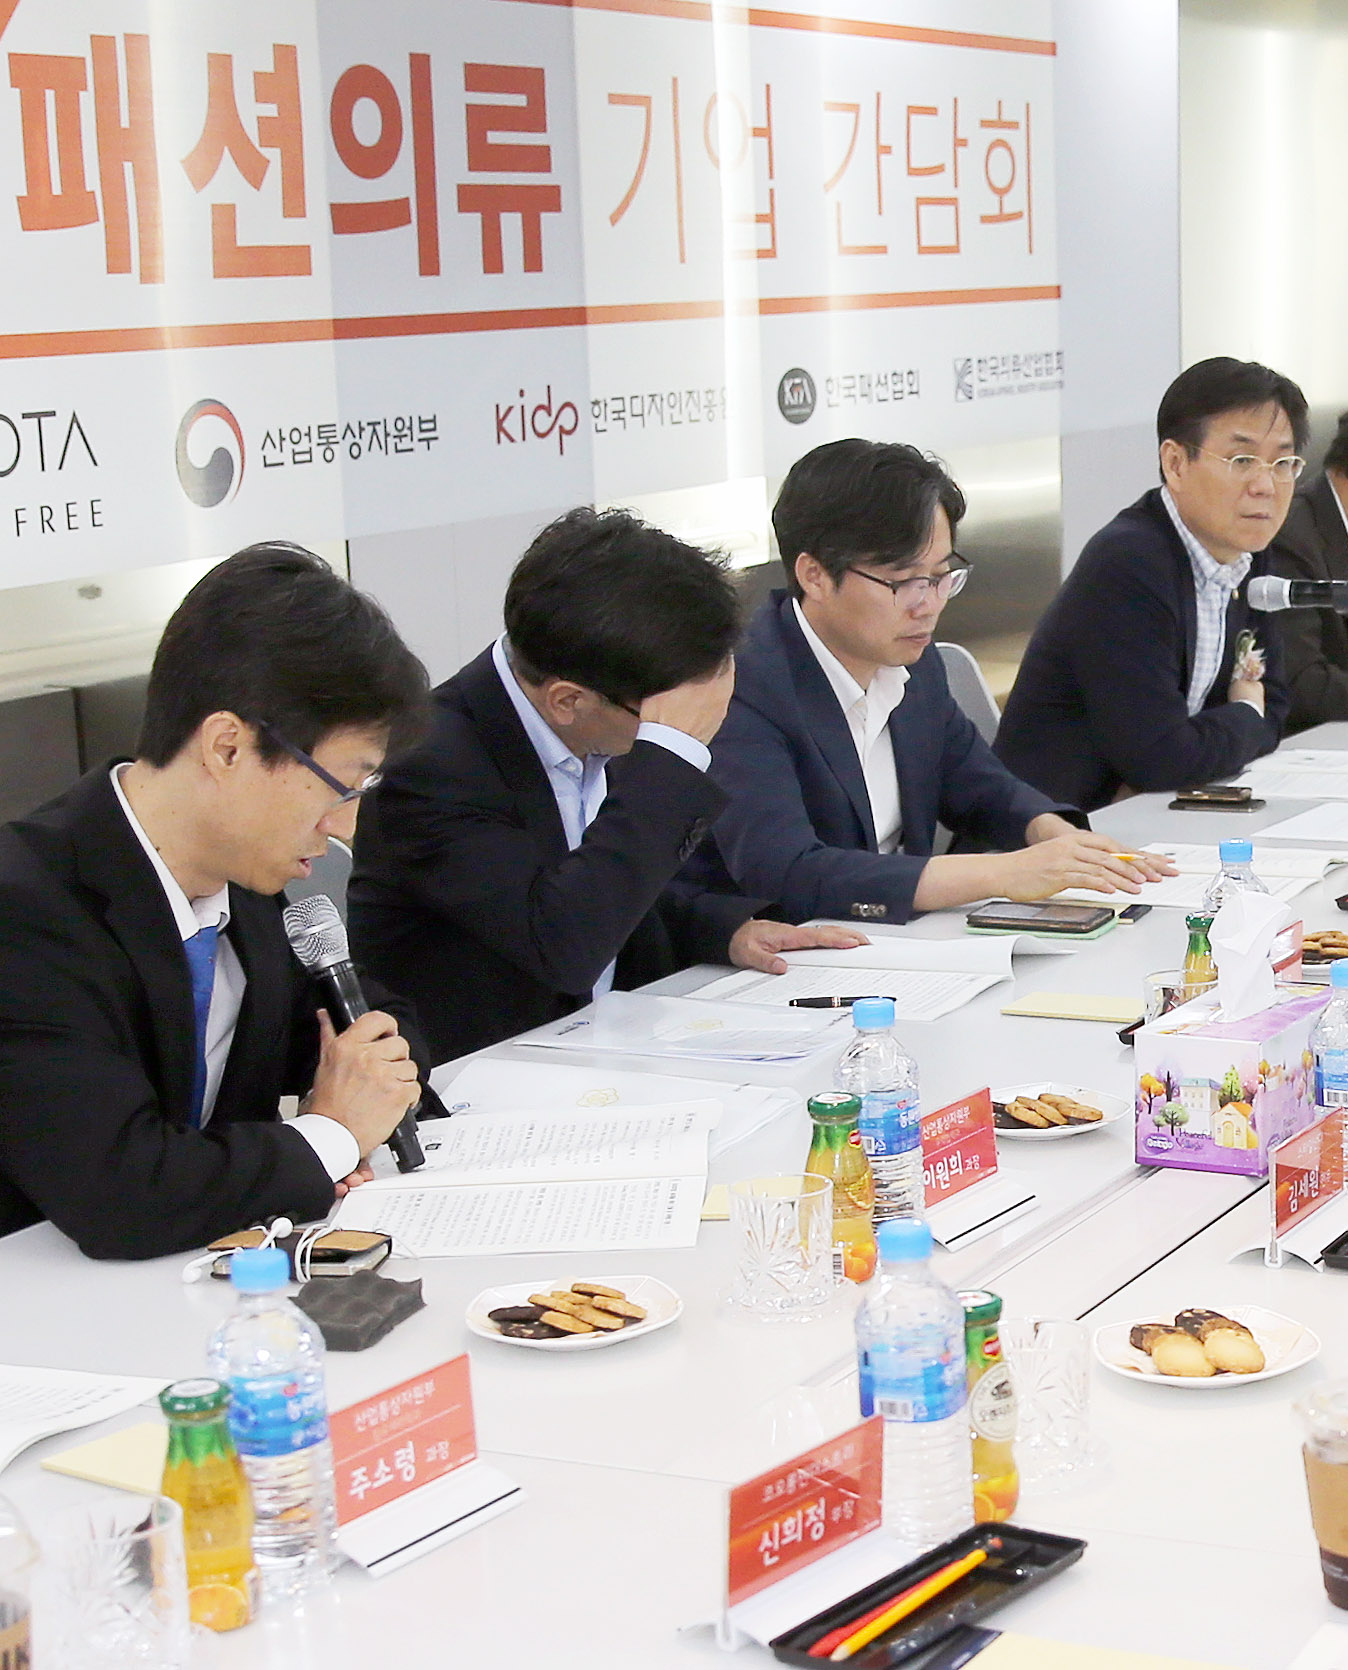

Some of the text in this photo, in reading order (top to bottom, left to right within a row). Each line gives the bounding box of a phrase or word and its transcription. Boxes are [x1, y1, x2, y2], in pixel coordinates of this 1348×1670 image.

[7, 33, 1034, 285] 패션의류 기업 간담회
[260, 413, 440, 468] 산업통상자원부
[14, 498, 104, 537] FREE
[923, 1150, 964, 1190] 이원희
[349, 1440, 417, 1501] 주소령
